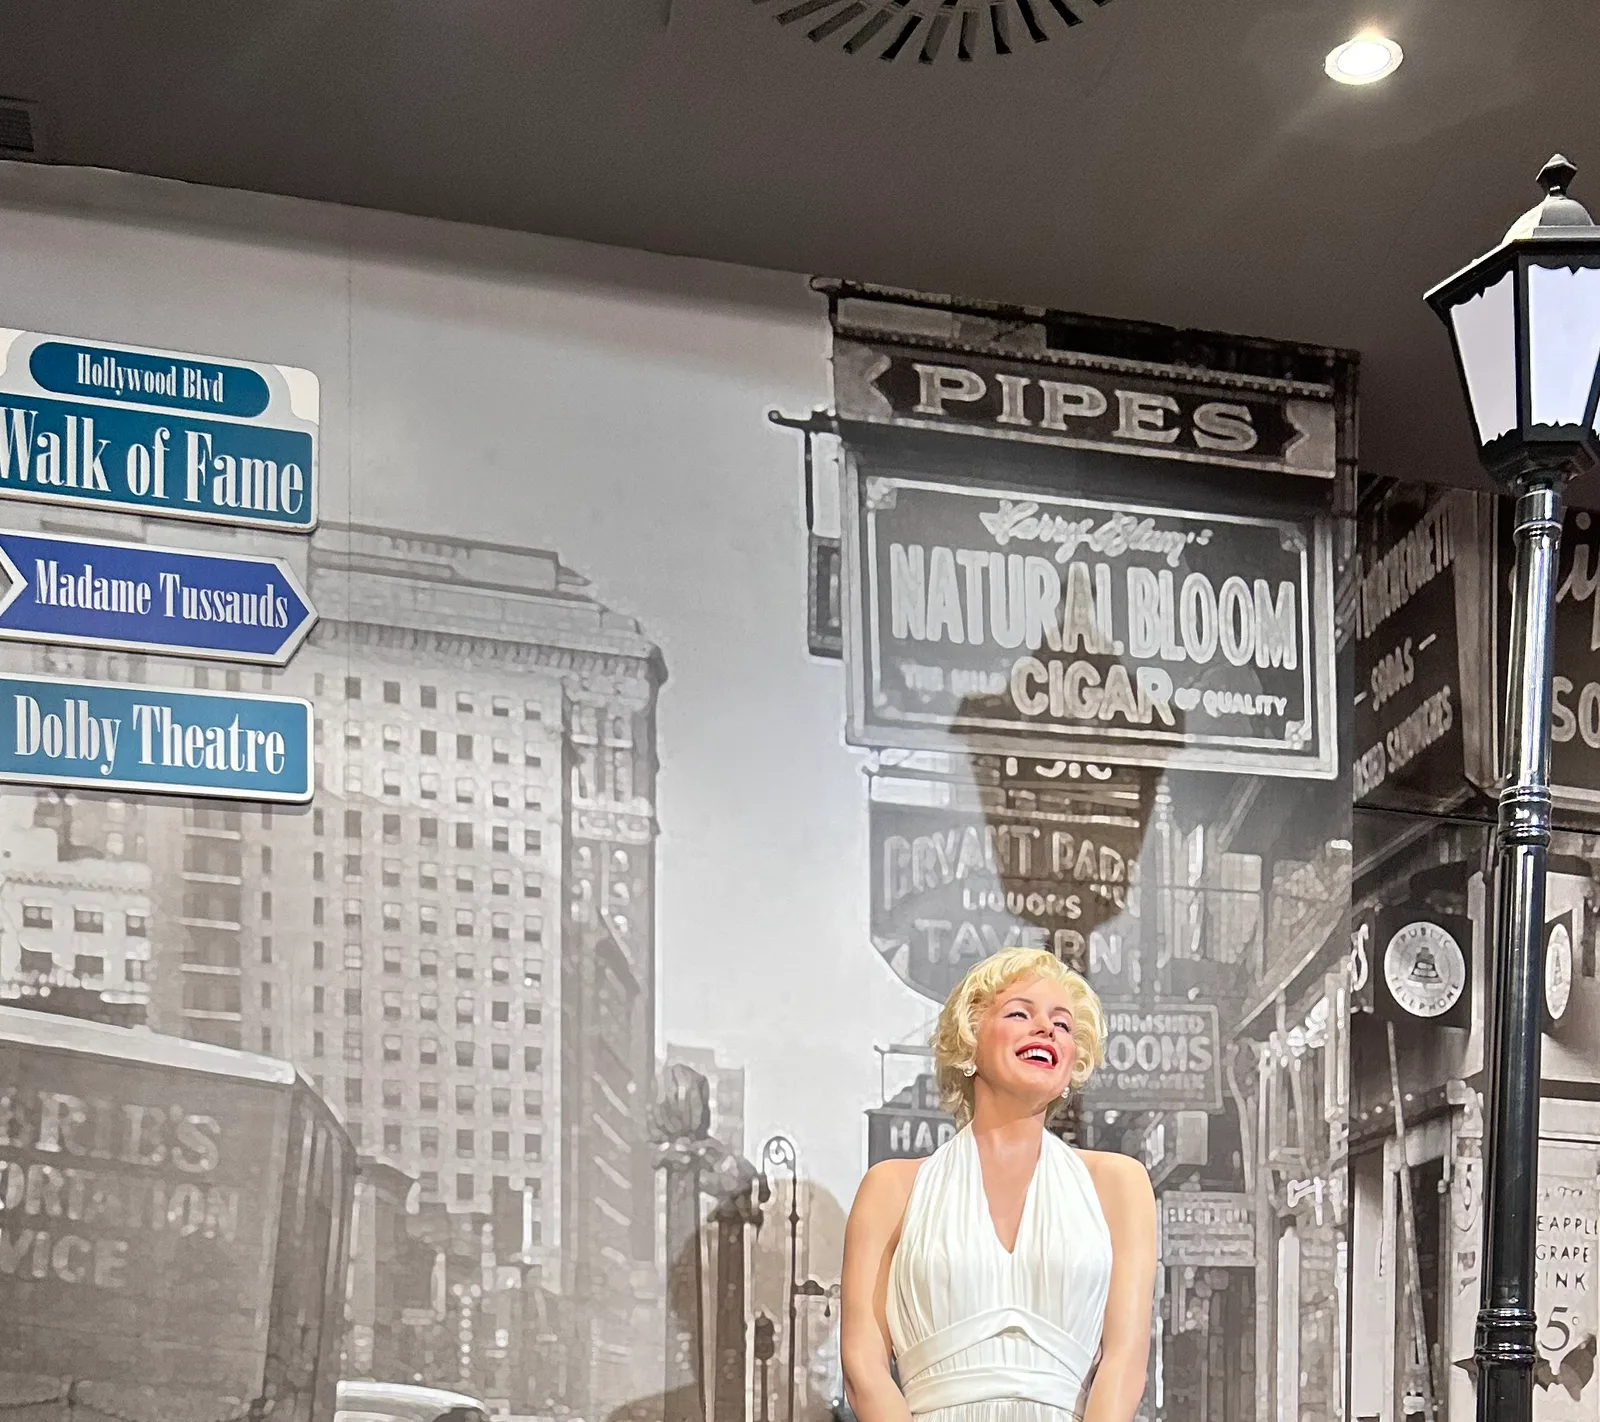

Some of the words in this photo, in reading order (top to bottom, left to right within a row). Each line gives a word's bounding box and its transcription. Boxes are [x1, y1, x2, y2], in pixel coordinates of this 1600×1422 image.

[77, 353, 177, 397] Hollywood
[183, 367, 225, 403] Blvd
[912, 363, 1258, 452] PIPES
[0, 406, 111, 493] Walk
[126, 427, 171, 500] of
[184, 430, 304, 515] Fame
[35, 559, 151, 616] Madame
[159, 572, 289, 629] Tussauds
[889, 542, 1125, 657] NATURAL
[1127, 566, 1297, 670] BLOOM
[1010, 656, 1177, 726] CIGAR
[1202, 689, 1288, 718] QUALITY
[14, 694, 122, 776] Dolby
[132, 703, 286, 775] Theatre
[963, 887, 1082, 919] LIQUORS
[1102, 1034, 1213, 1072] OOMS
[1535, 1244, 1589, 1264] GRAPE
